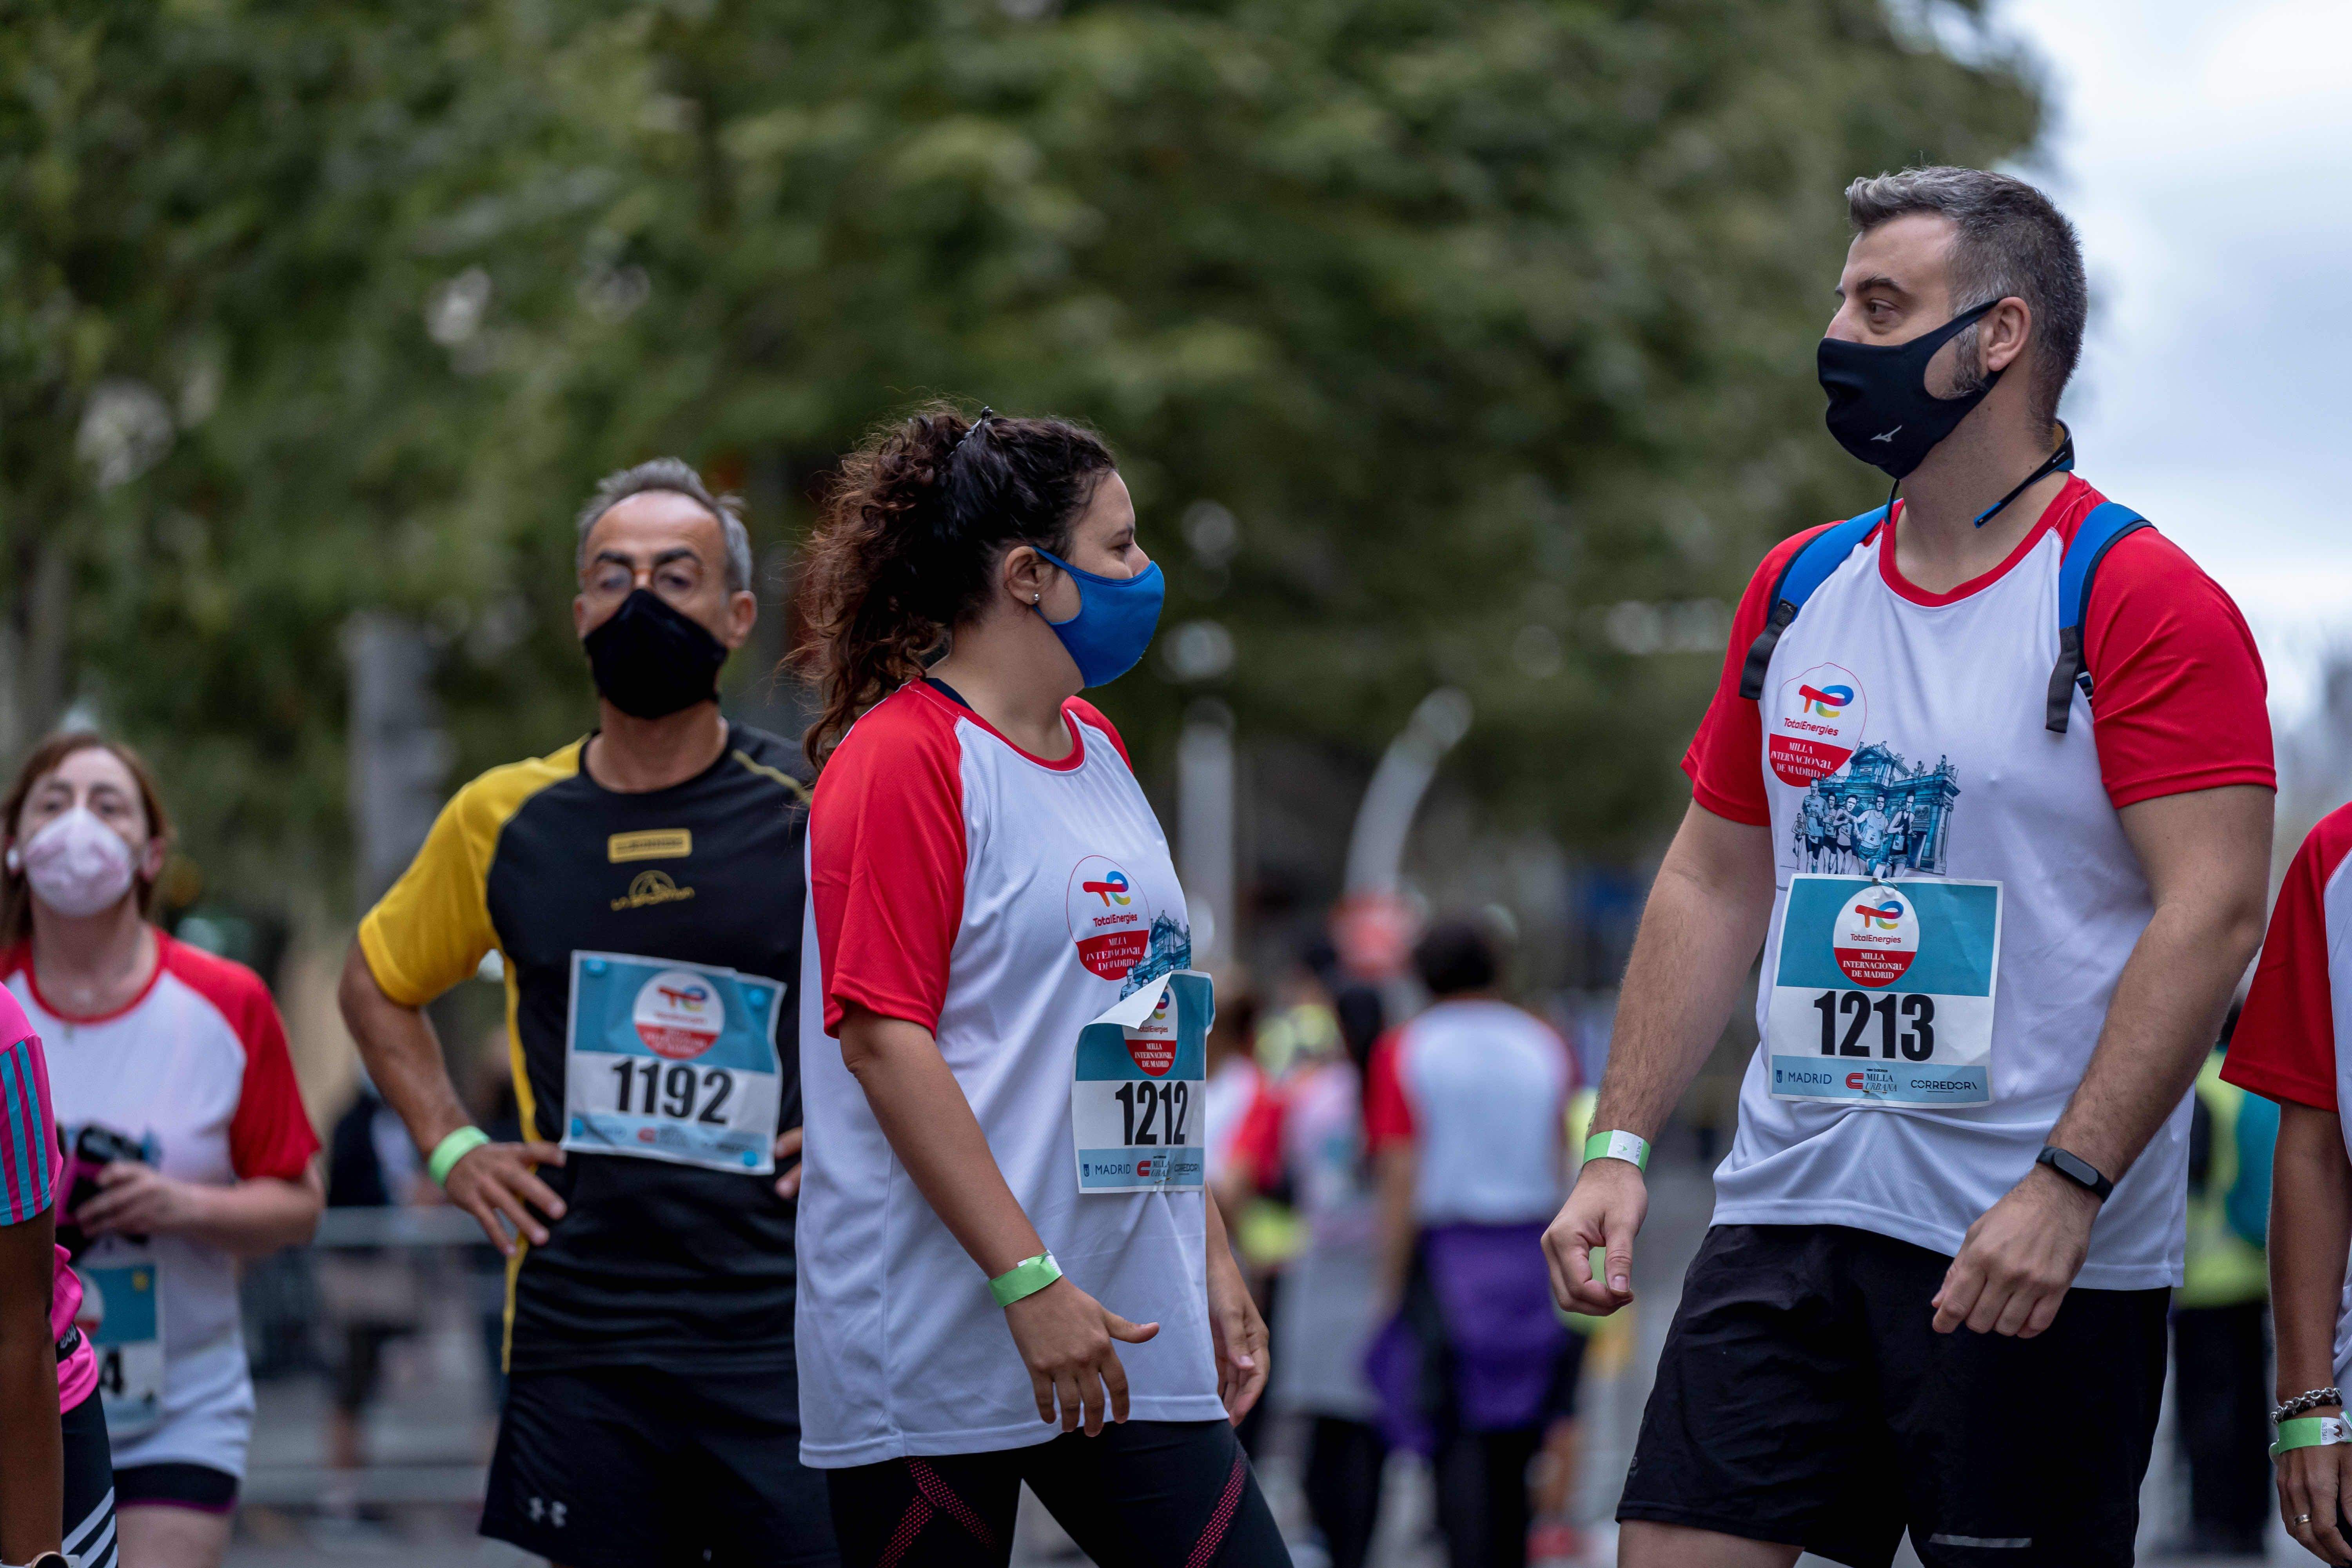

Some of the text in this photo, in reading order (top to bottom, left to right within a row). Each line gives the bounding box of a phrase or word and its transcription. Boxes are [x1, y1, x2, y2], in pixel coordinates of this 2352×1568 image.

[1784, 717, 1839, 736] TotalEnergies
[1789, 742, 1813, 754] MILLA
[1777, 763, 1820, 778] DE MADRID
[1093, 912, 1138, 927] TotalEnergies
[1851, 934, 1901, 944] TotalEnergies
[1814, 990, 1935, 1061] 1213
[1789, 1072, 1832, 1084] MADRID
[1866, 1073, 1894, 1082] MILLA
[612, 1056, 734, 1125] 1192
[1866, 1082, 1897, 1091] URBANA
[1115, 1080, 1188, 1146] 1212
[1095, 1164, 1131, 1174] MADRID
